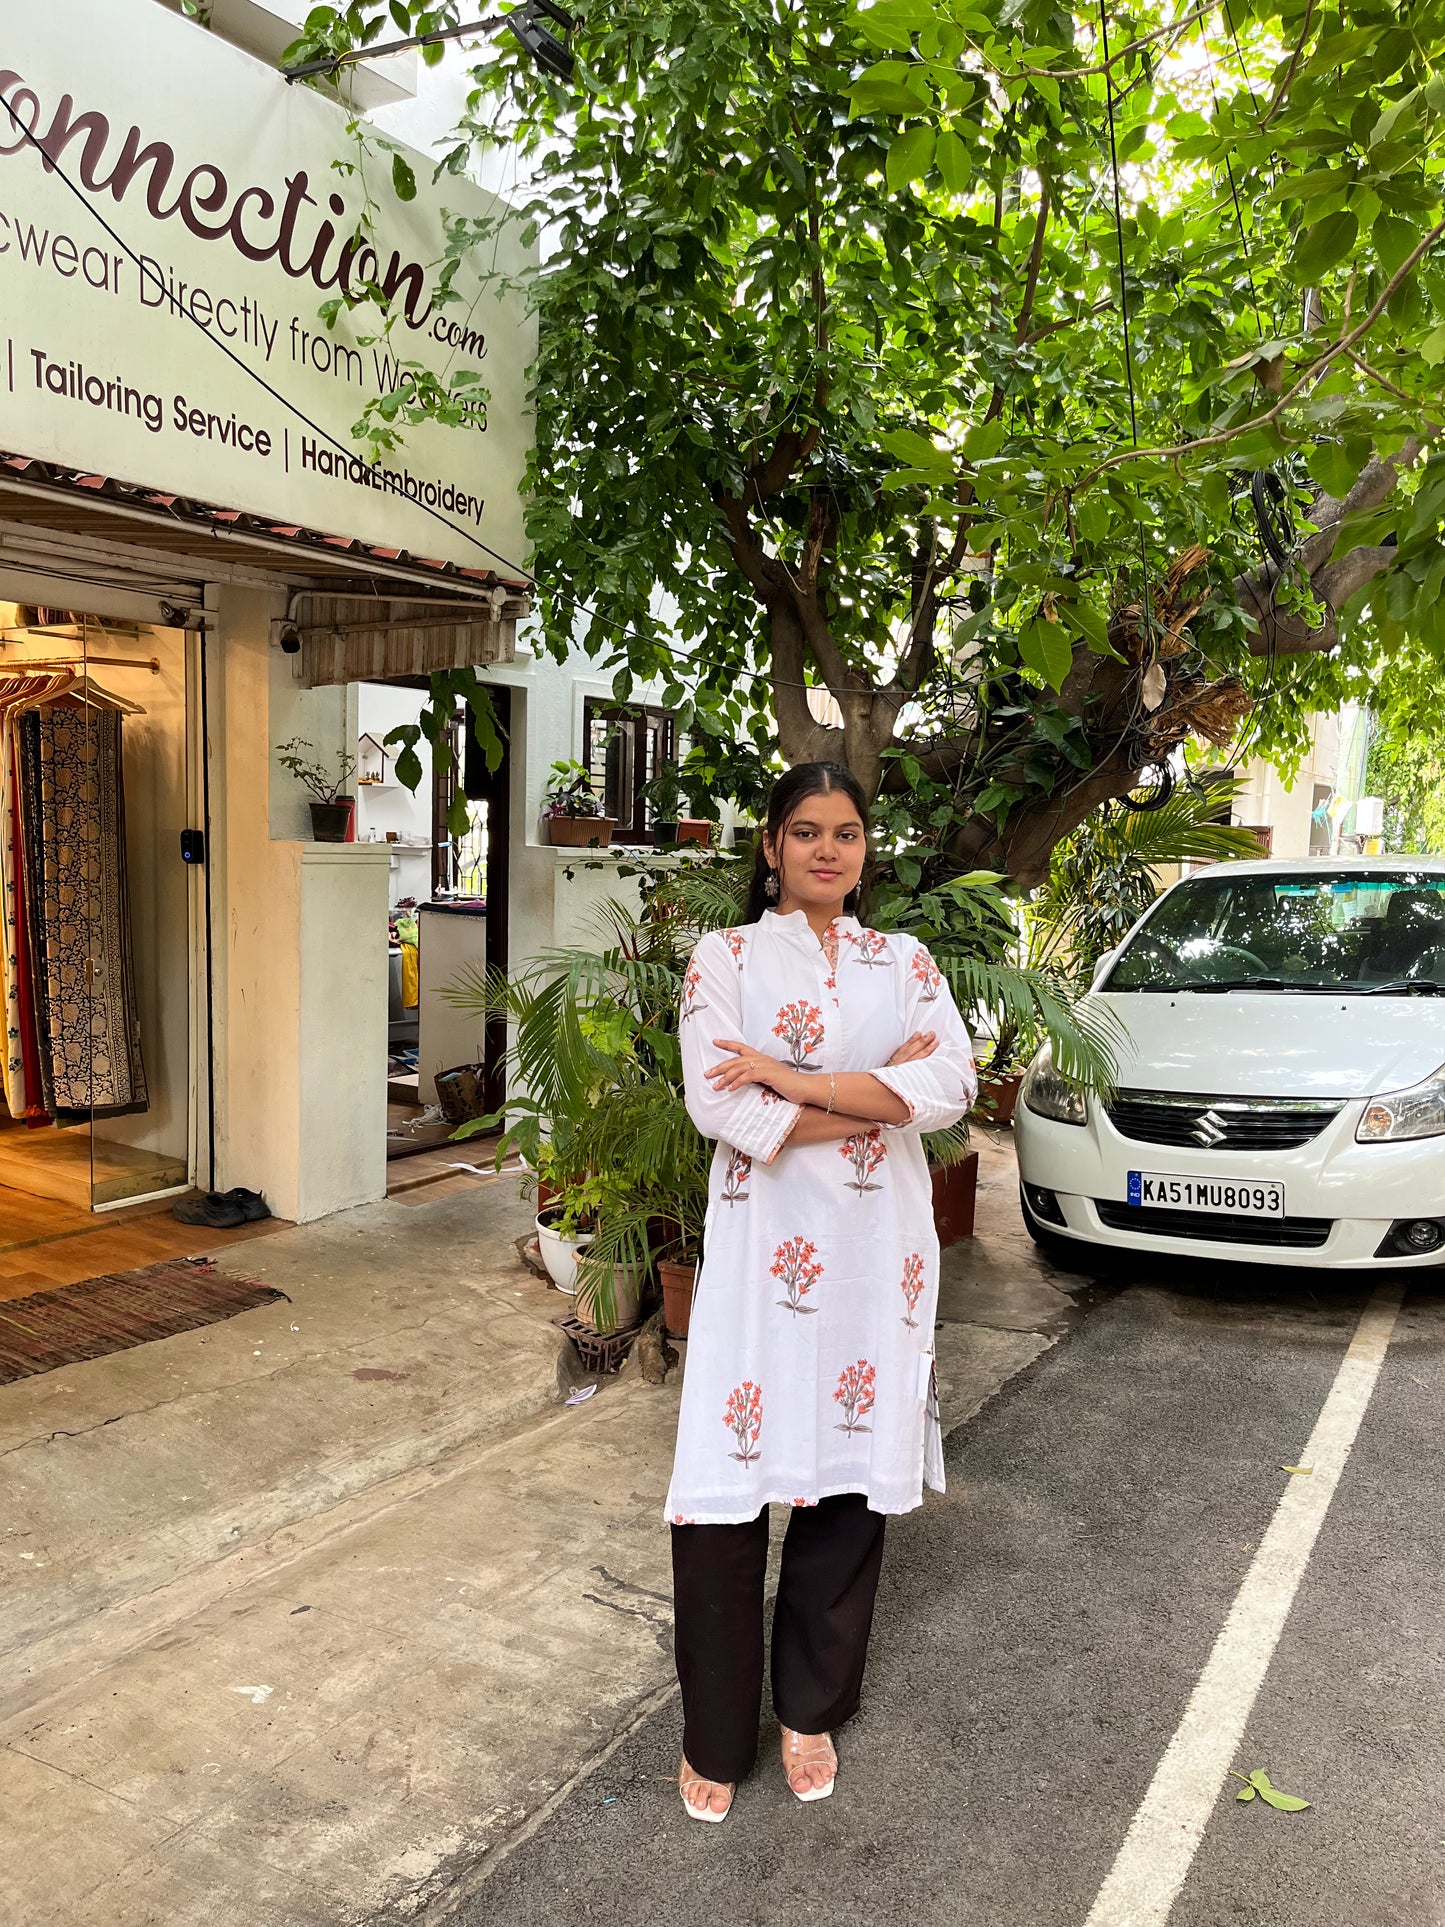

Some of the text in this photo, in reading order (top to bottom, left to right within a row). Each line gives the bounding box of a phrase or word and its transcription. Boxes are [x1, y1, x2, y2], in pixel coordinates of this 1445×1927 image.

[139, 254, 279, 362] Directly
[289, 316, 363, 386] from
[30, 348, 163, 433] Tailoring
[173, 395, 272, 457] Service
[1143, 1179, 1280, 1211] KA51MU8093
